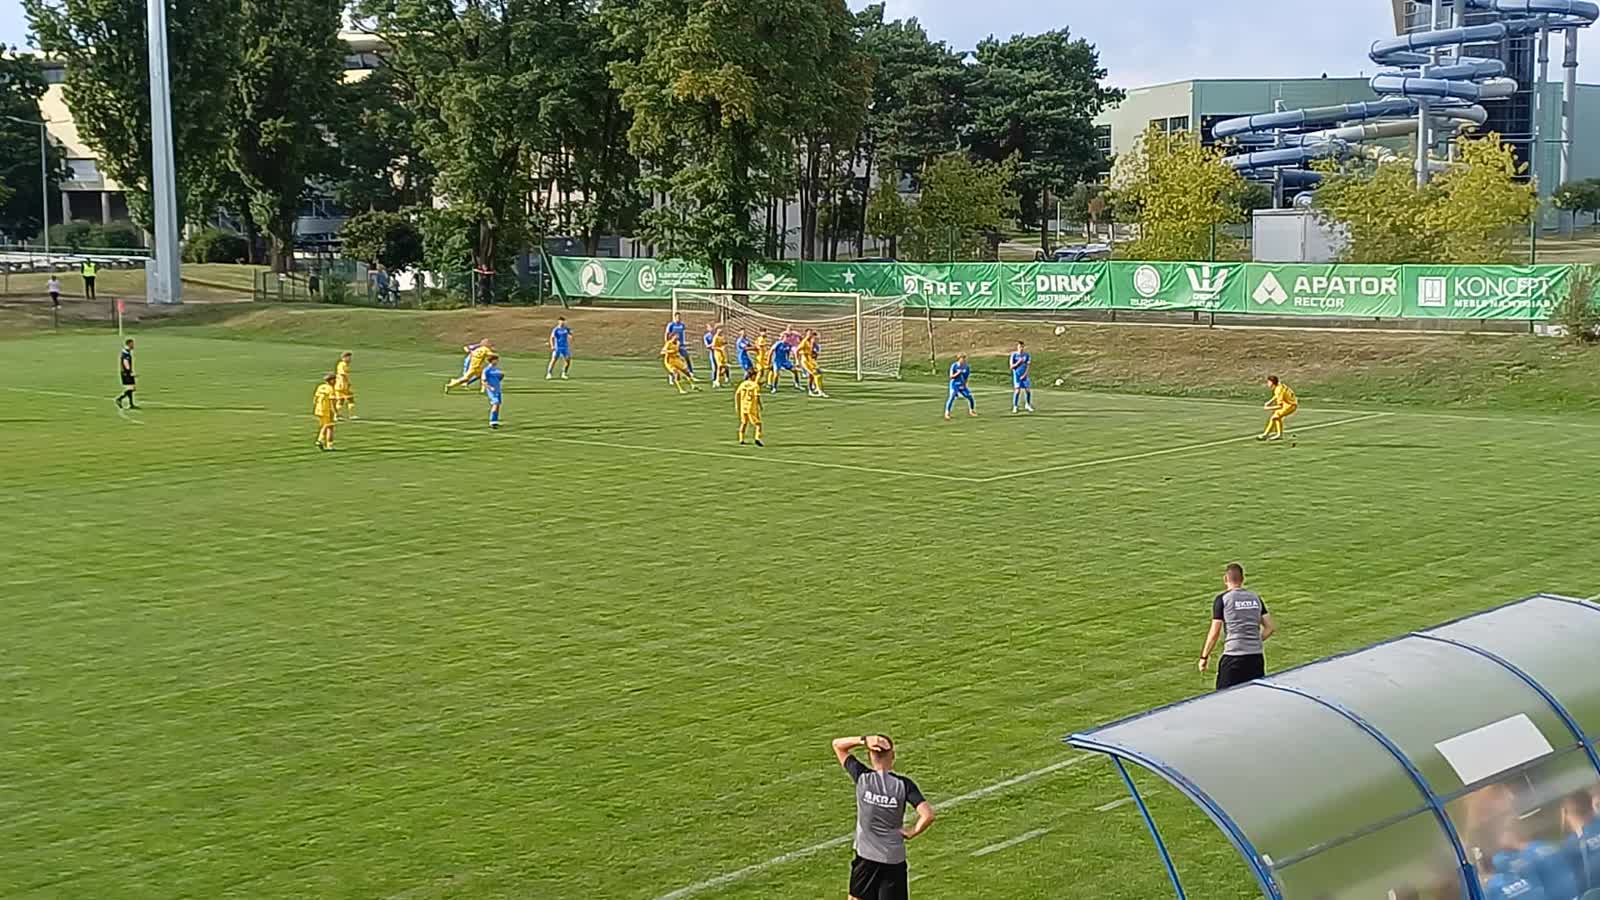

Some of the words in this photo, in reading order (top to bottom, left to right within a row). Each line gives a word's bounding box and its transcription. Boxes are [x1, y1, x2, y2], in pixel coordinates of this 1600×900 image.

[923, 281, 993, 296] BREVE
[1293, 276, 1397, 295] APATOR
[1454, 276, 1550, 297] KONCEPT
[1294, 297, 1344, 308] RECTOR
